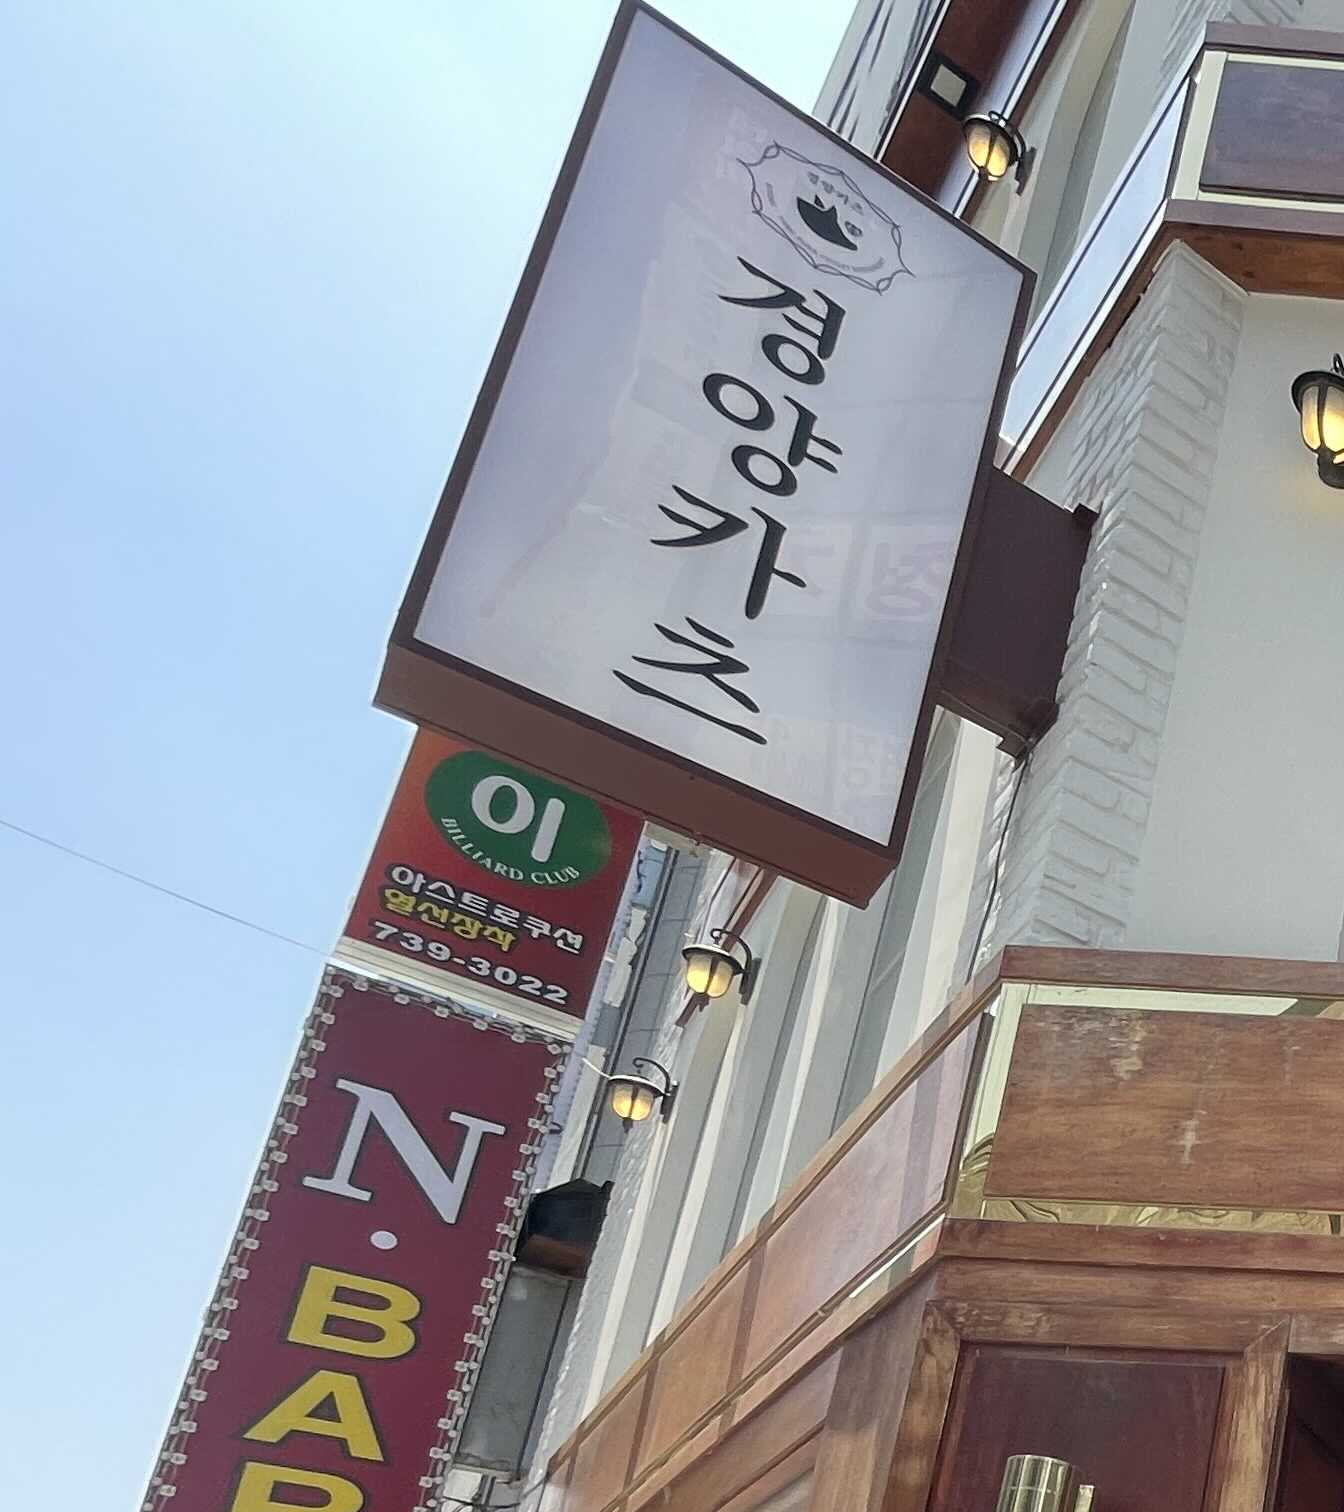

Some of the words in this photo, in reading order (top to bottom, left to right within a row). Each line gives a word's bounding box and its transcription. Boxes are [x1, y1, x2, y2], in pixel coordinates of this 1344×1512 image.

[613, 256, 847, 744] 경양카츠
[441, 816, 524, 882] BILLIARD
[530, 864, 581, 886] CLUB
[373, 921, 569, 1005] 739-3022
